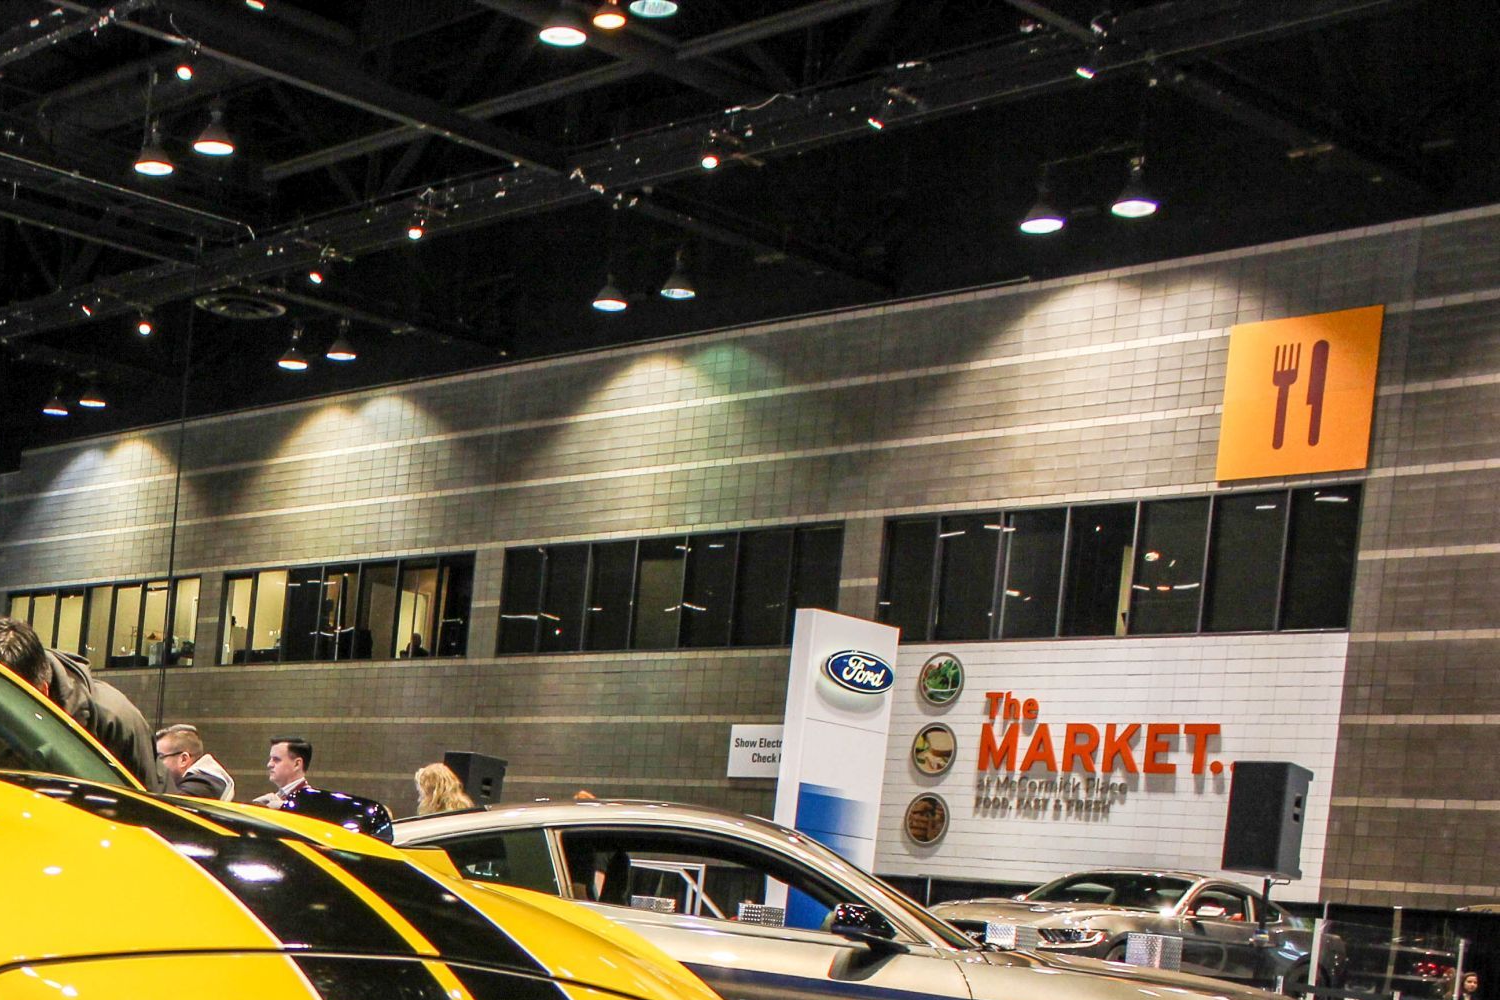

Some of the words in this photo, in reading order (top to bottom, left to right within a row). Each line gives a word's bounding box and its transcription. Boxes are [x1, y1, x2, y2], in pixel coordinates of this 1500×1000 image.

[841, 655, 886, 688] Ford
[985, 691, 1039, 720] The
[734, 737, 757, 749] Show
[751, 752, 777, 764] Check
[976, 777, 991, 792] at
[996, 776, 1081, 793] McCormick
[1085, 777, 1128, 795] Place
[974, 796, 1013, 811] FOOD,
[1016, 797, 1050, 811] FAST
[1065, 798, 1111, 813] FRESH
